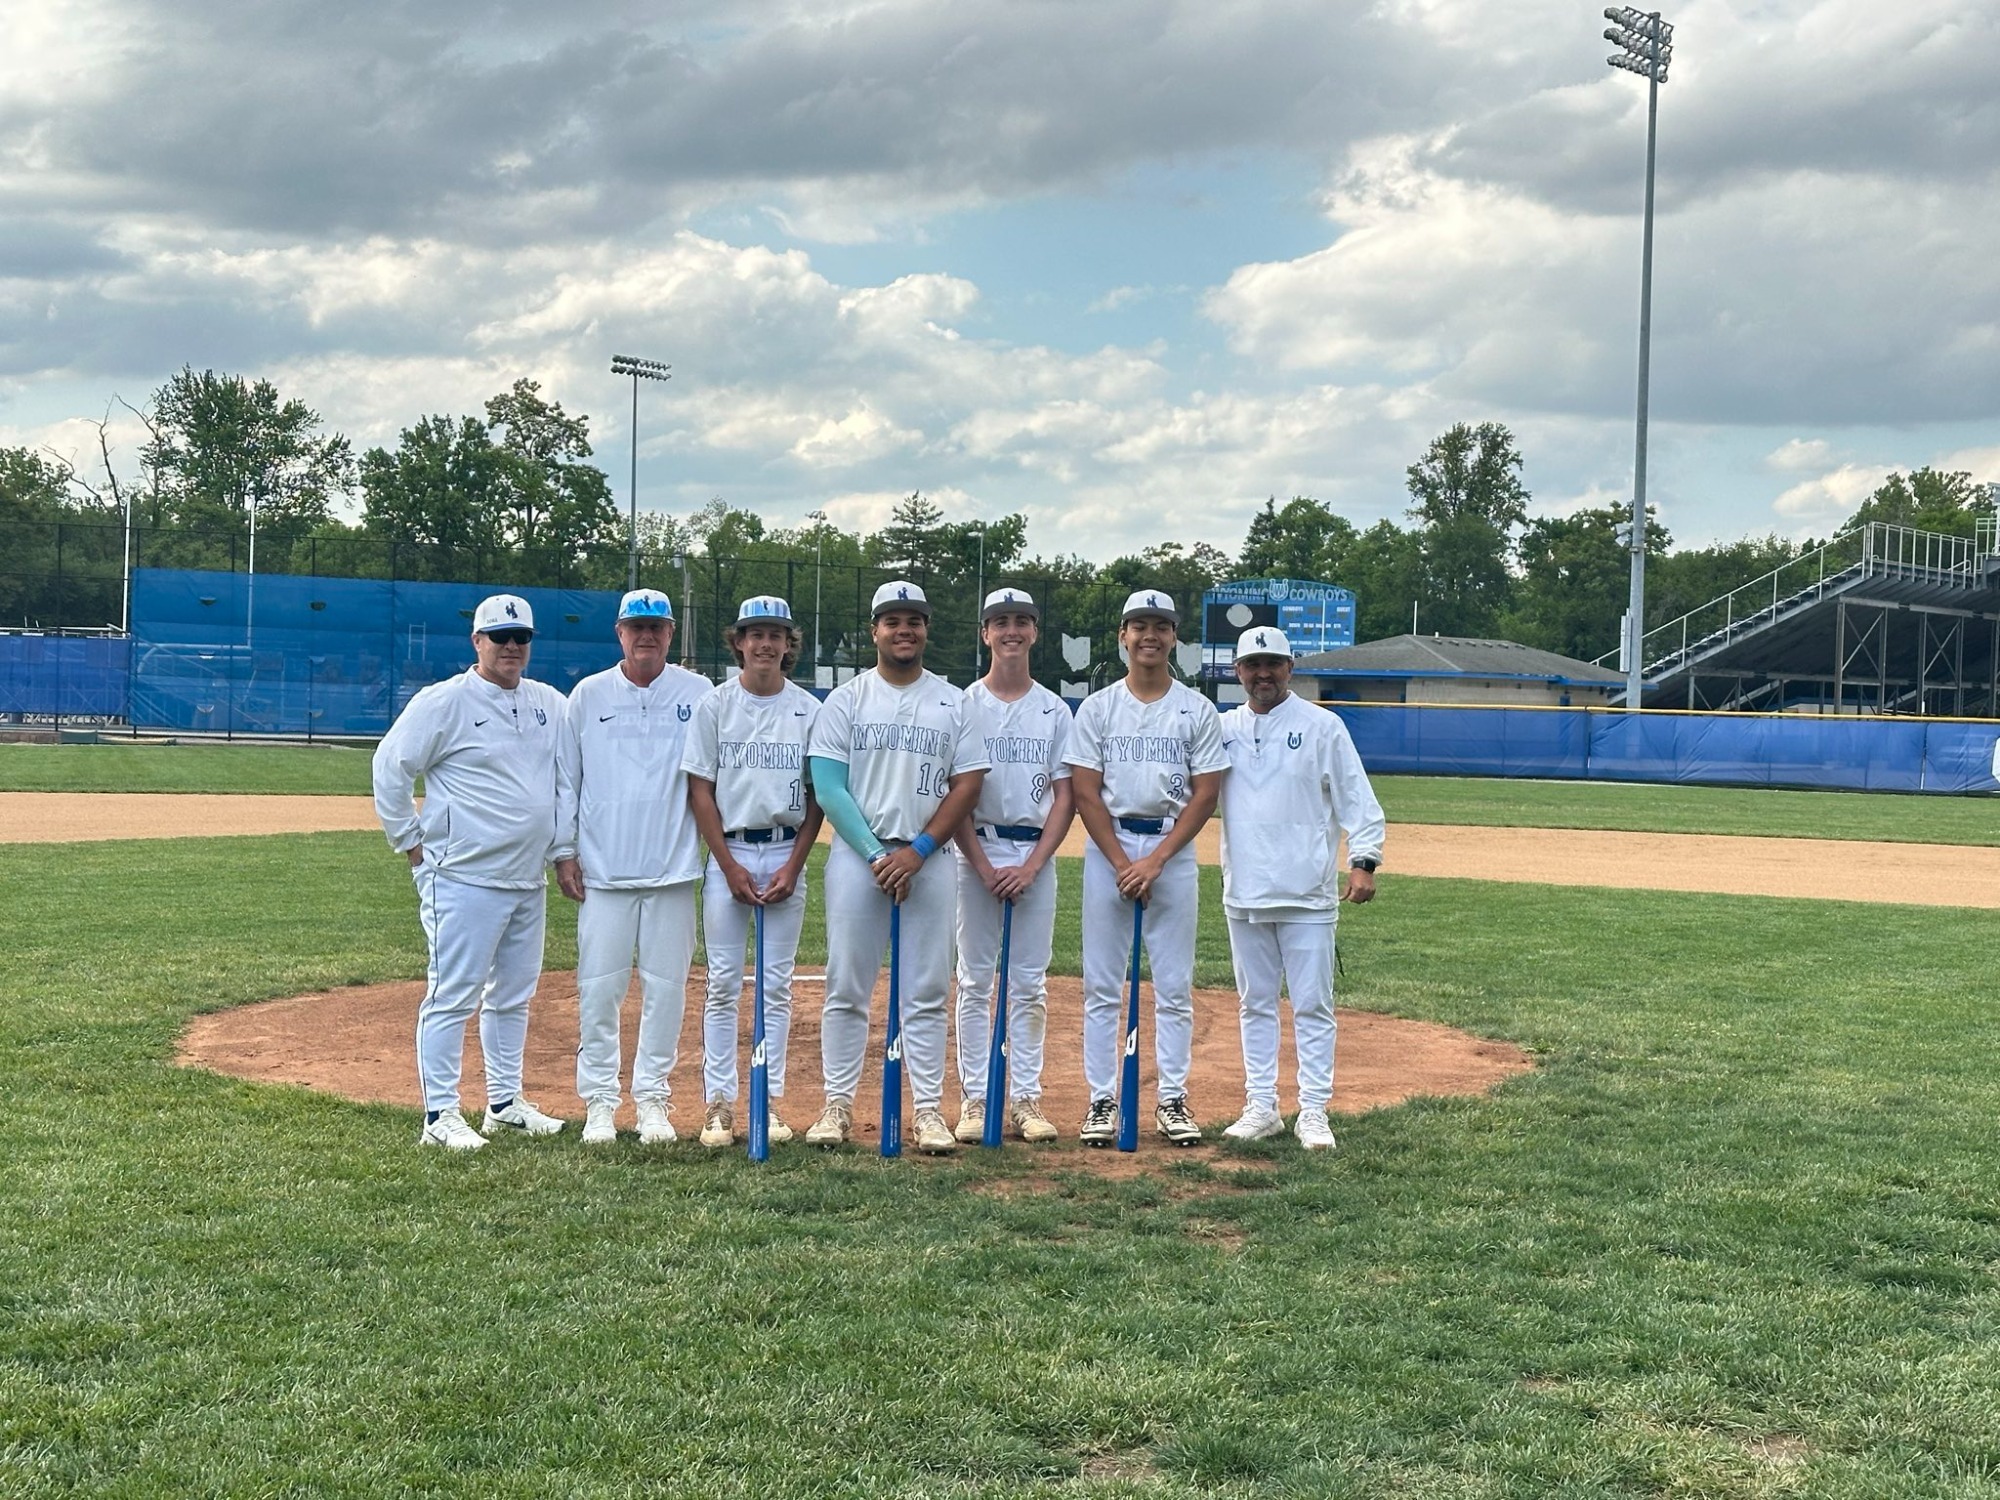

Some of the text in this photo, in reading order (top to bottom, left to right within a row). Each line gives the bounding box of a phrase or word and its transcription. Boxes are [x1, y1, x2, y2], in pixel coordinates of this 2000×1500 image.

[1289, 588, 1348, 601] COWBOYS
[851, 723, 951, 758] WYOMING
[983, 736, 1054, 765] YOMIN
[1030, 773, 1047, 804] 8
[1166, 773, 1185, 801] 3
